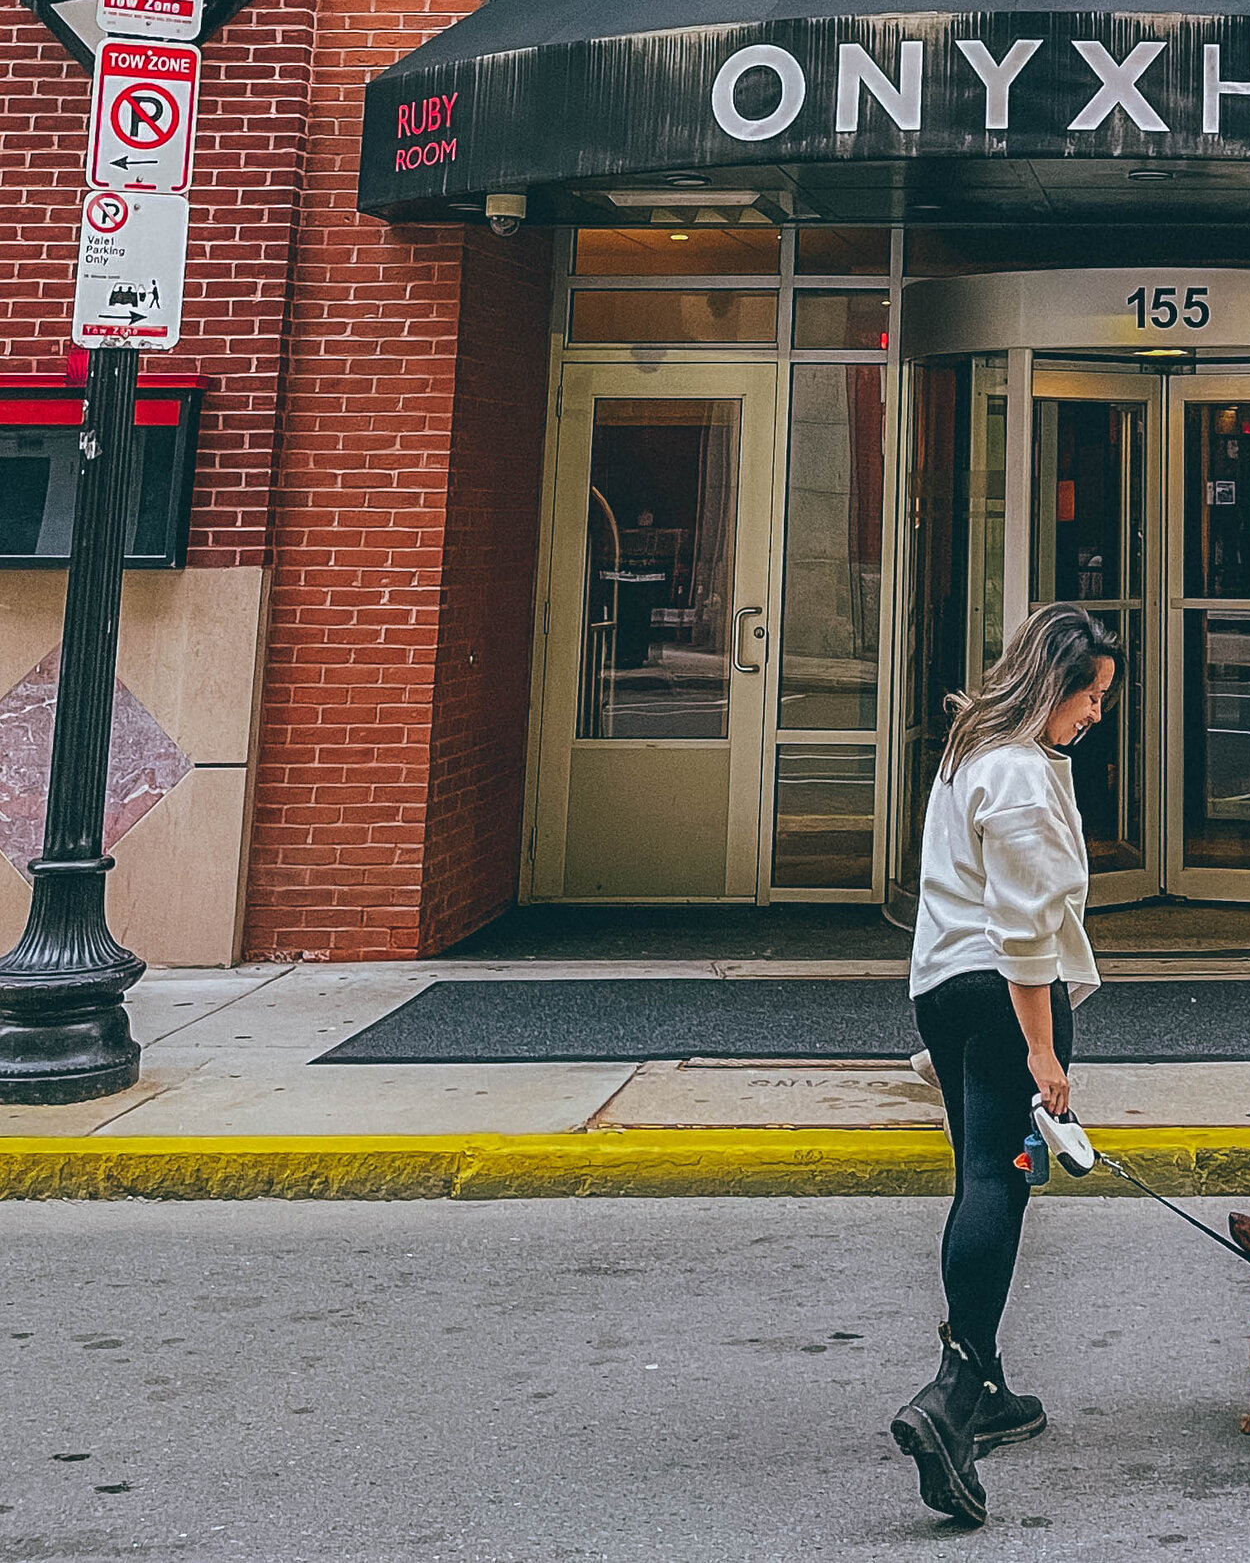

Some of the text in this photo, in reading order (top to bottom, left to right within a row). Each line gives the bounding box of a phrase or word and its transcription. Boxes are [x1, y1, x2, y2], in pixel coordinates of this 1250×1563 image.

[108, 52, 191, 73] TOW ZONE
[710, 38, 1171, 141] ONYX
[397, 92, 459, 139] RUBY
[395, 138, 457, 172] ROOM
[85, 245, 126, 256] Parking
[87, 236, 115, 245] Valet
[85, 255, 110, 266] Only
[1127, 286, 1210, 329] 155
[85, 325, 108, 334] Tow
